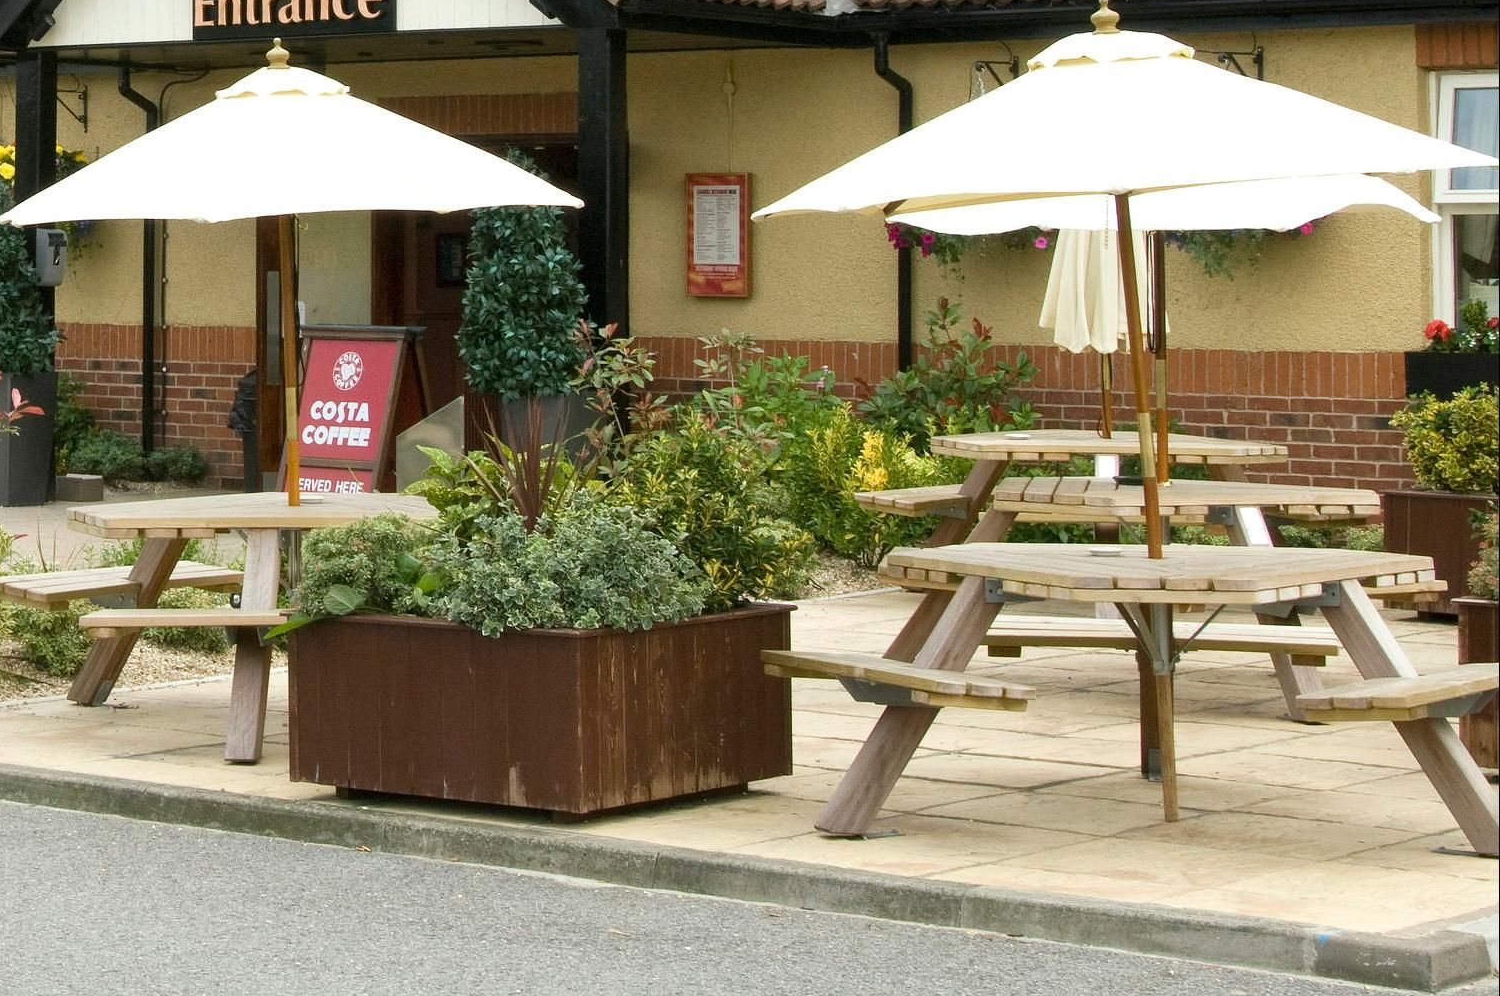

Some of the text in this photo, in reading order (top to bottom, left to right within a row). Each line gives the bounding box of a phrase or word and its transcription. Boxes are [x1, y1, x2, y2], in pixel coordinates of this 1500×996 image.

[339, 354, 360, 365] COSTA
[310, 400, 369, 423] COSTA
[302, 425, 371, 447] COFFEE
[298, 478, 364, 494] ERVED HERE
